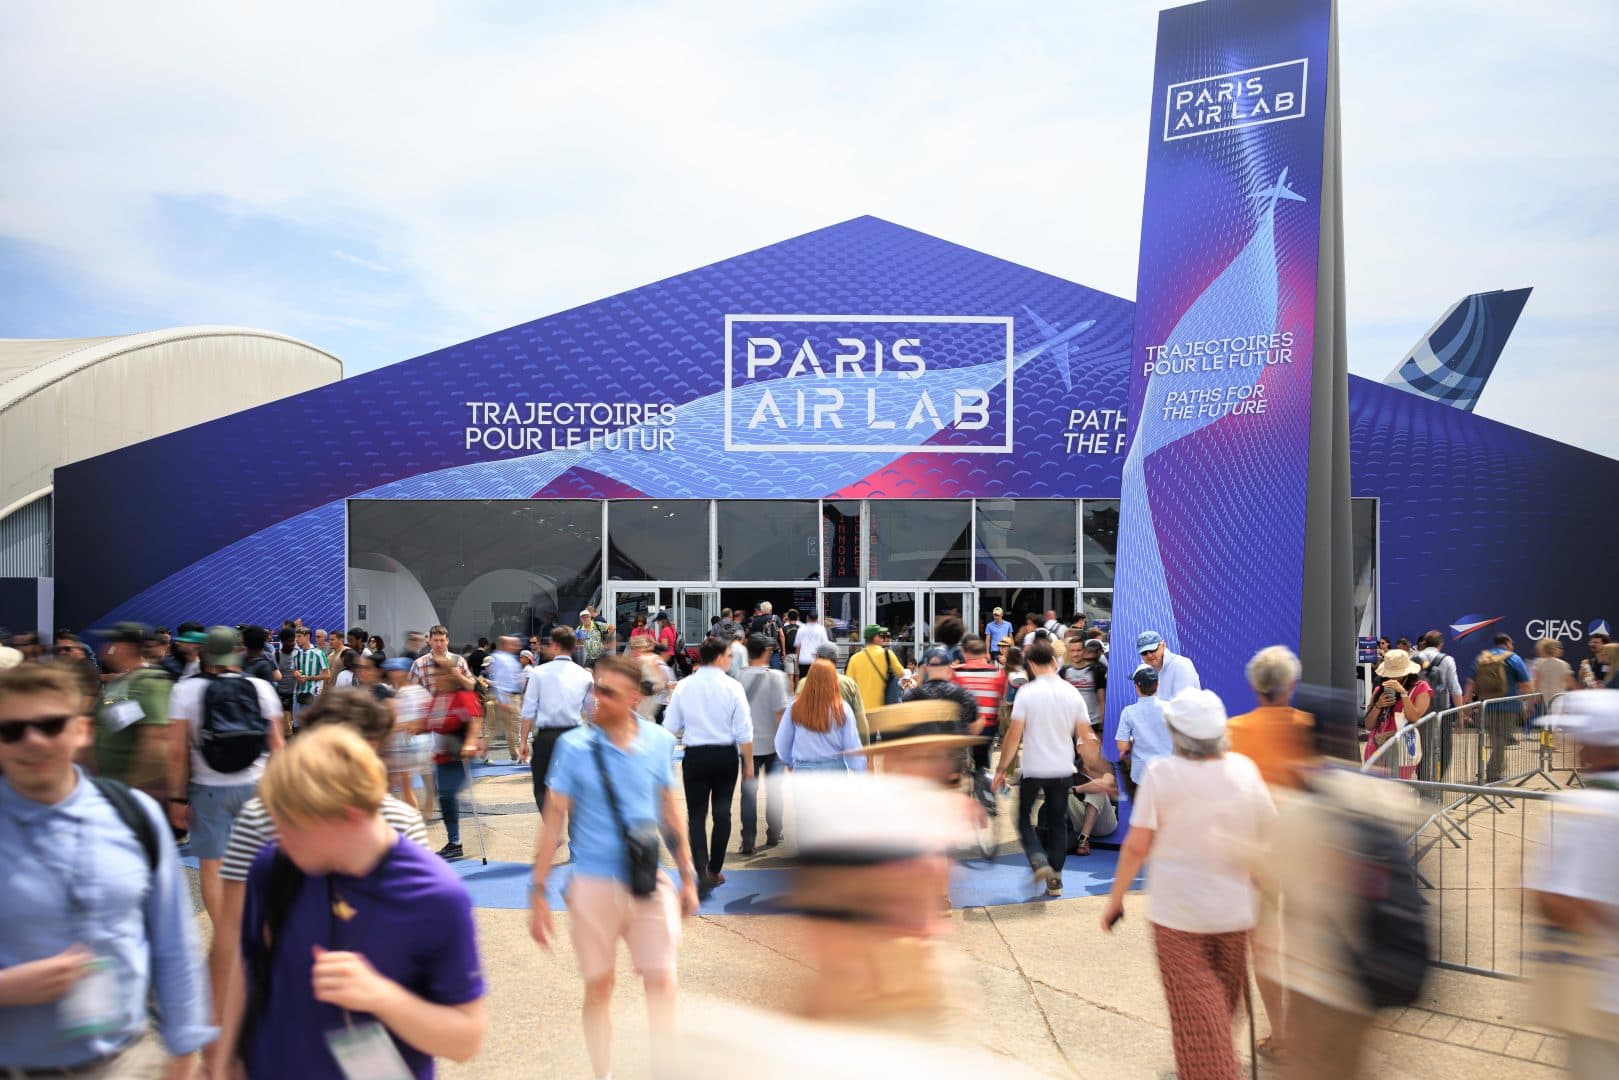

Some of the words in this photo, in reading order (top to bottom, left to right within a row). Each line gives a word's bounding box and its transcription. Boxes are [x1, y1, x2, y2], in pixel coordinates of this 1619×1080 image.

[1176, 76, 1264, 110] PARIS
[1174, 105, 1221, 131] AIR
[1231, 91, 1295, 120] LAB
[747, 337, 926, 379] PARIS
[1145, 331, 1294, 361] TRAJECTOIRES
[1143, 357, 1197, 377] POUR
[1202, 354, 1224, 371] LE
[1229, 348, 1293, 369] FUTUR
[747, 387, 844, 430] AIR
[867, 387, 990, 430] LAB
[1165, 387, 1222, 406] PATHS
[1226, 384, 1265, 401] FOR
[466, 401, 677, 426] TRAJECTOIRES
[1162, 405, 1193, 422] THE
[1198, 399, 1268, 419] FUTURE
[465, 427, 543, 450] POUR
[551, 428, 581, 450] LE
[589, 428, 676, 451] FUTUR
[1063, 433, 1110, 454] THE
[1525, 619, 1583, 641] GIFAS
